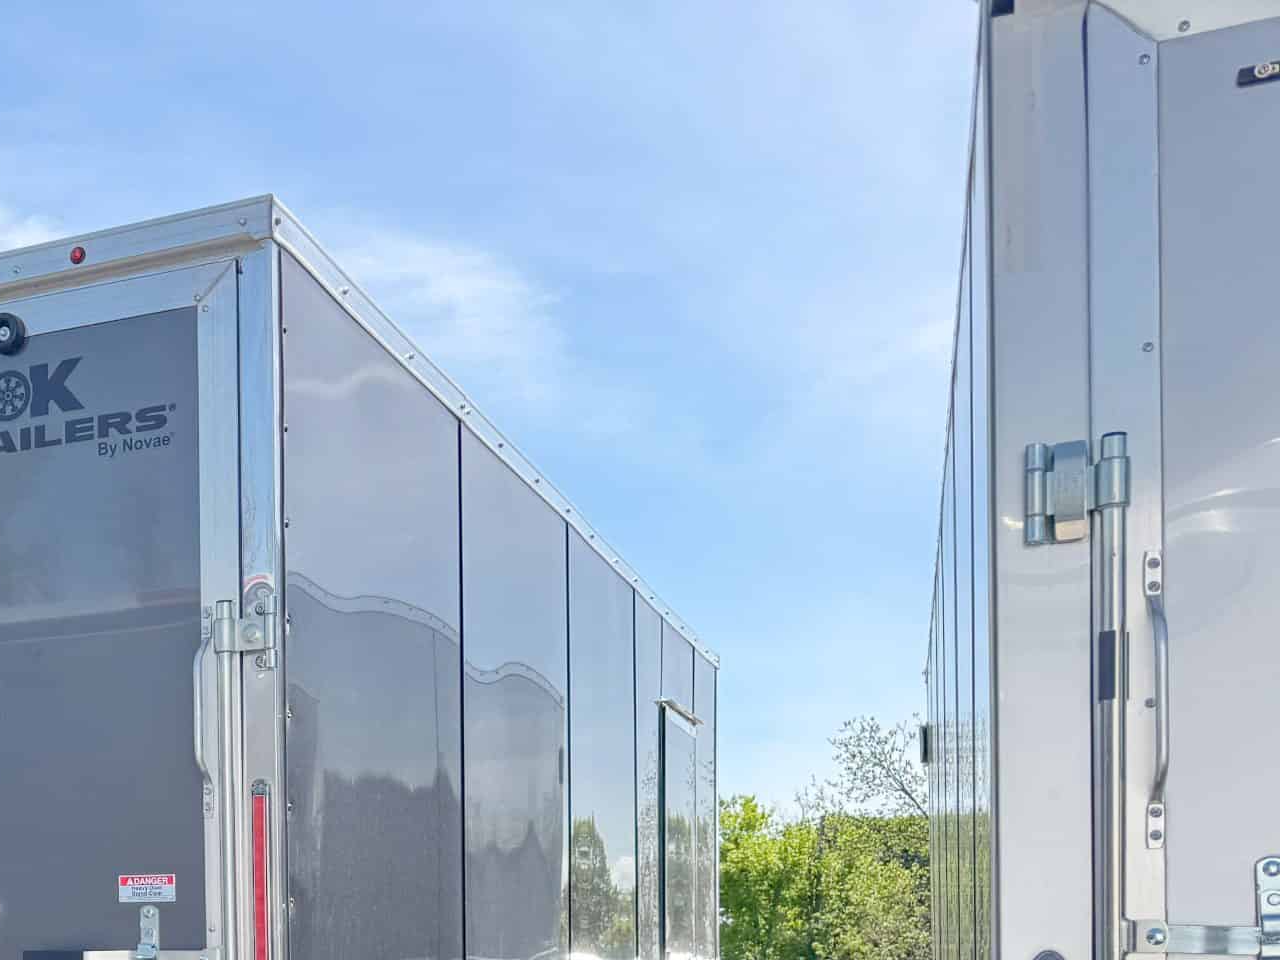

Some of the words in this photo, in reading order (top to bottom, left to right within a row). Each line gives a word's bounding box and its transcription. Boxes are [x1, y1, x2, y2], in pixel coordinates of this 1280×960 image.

[97, 442, 117, 458] By
[122, 435, 171, 452] Novae
[133, 877, 169, 885] DANGER
